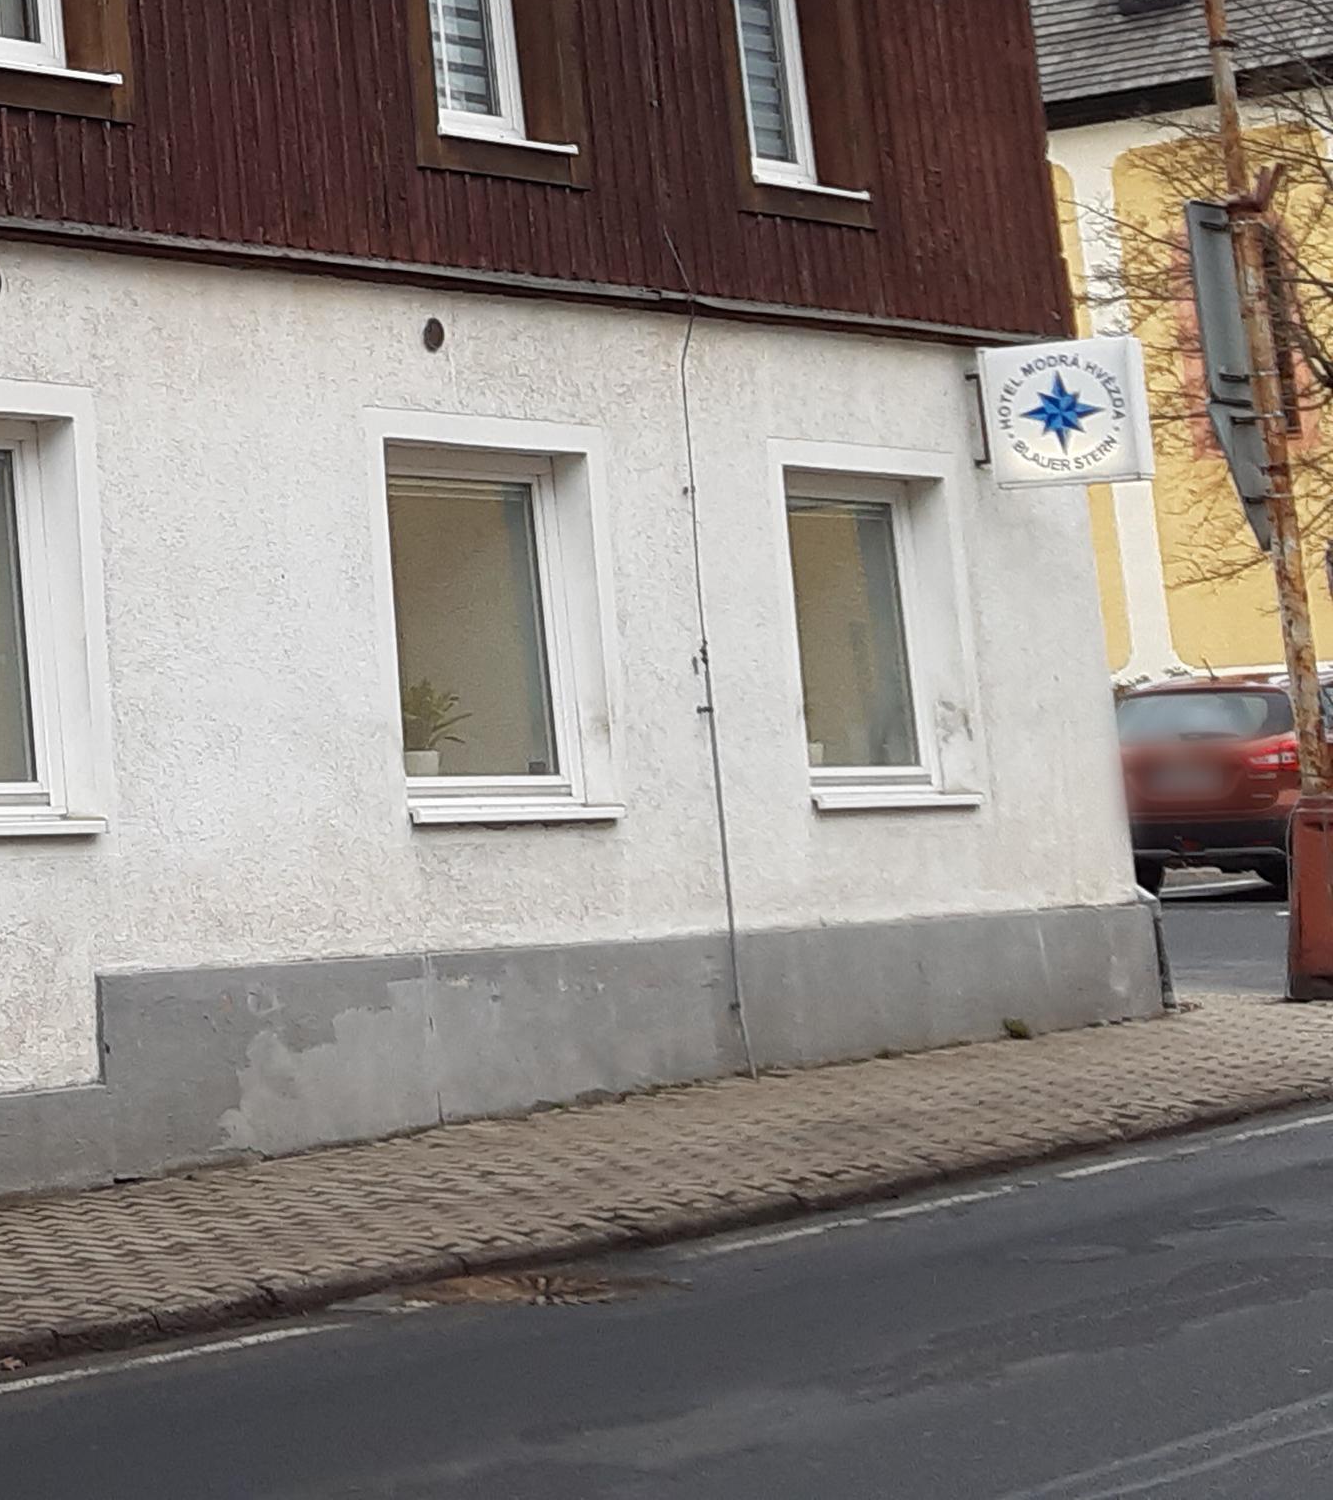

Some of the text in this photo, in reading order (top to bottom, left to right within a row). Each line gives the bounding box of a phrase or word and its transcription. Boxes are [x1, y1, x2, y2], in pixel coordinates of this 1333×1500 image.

[997, 378, 1024, 430] HOTEL
[1020, 353, 1080, 377] MODRÁ
[1013, 435, 1118, 471] BLAUER STERN
